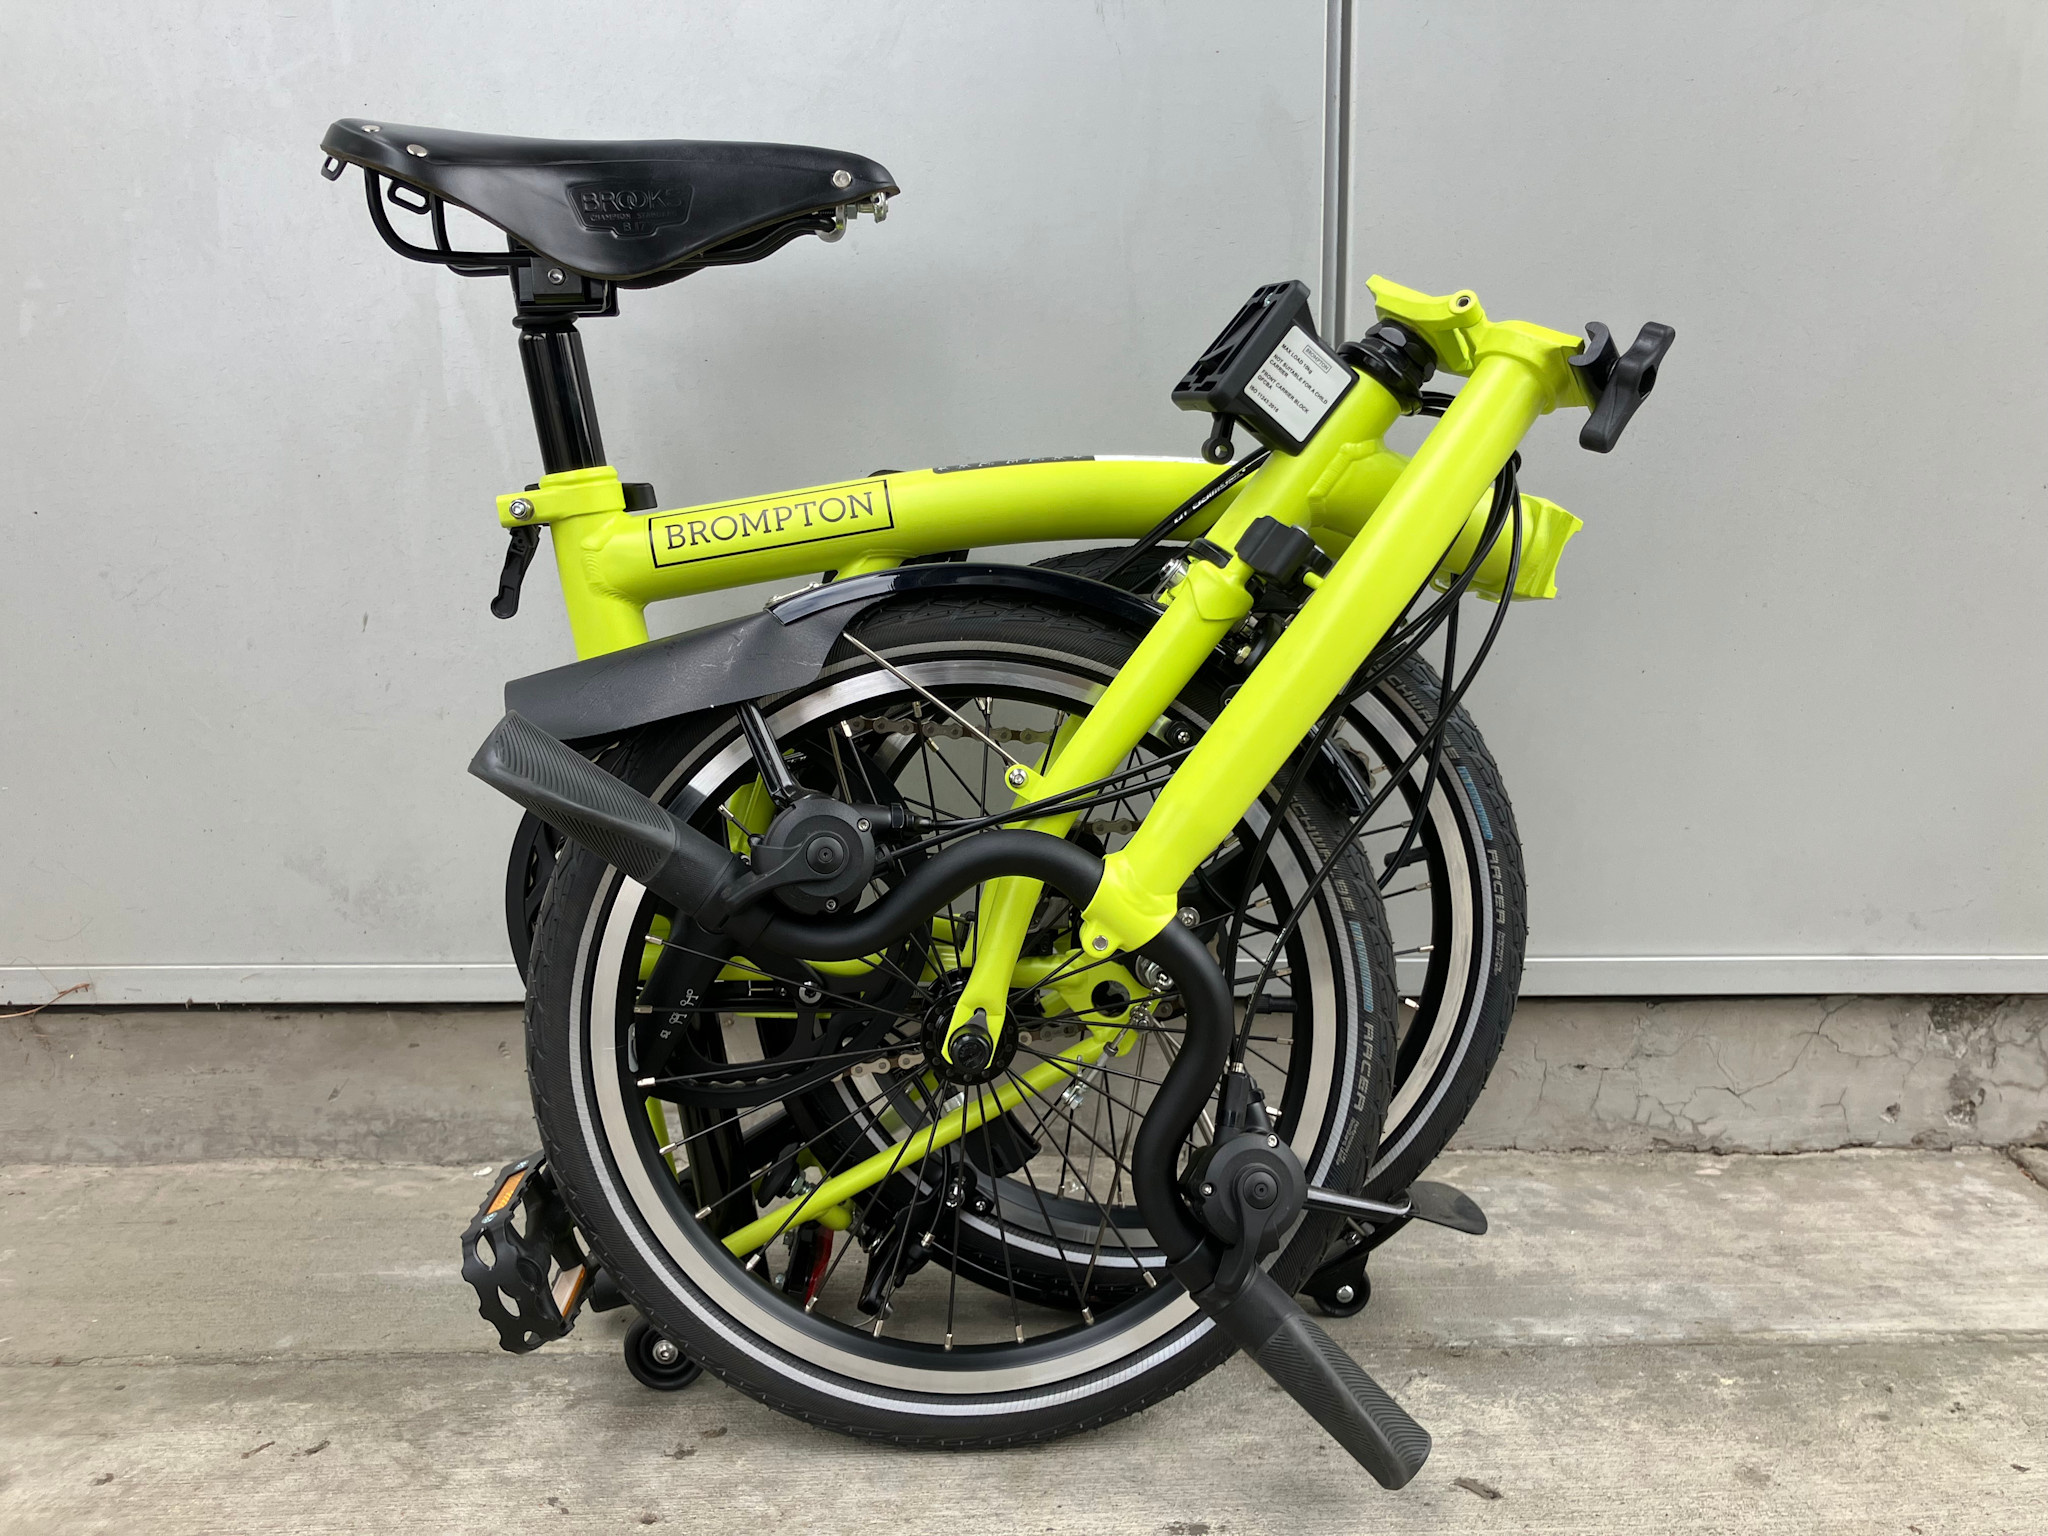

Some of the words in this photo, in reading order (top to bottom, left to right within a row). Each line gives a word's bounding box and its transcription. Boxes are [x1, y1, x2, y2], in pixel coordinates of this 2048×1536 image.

[581, 189, 682, 212] BROOKS
[1268, 359, 1289, 377] CARRIER
[1280, 343, 1292, 354] MAX
[1290, 352, 1304, 365] LOAD
[1304, 348, 1329, 370] BROMPTON
[1248, 384, 1258, 393] ISO
[1260, 369, 1276, 384] FRONT
[1274, 382, 1294, 400] CARRIER
[1293, 398, 1309, 413] BLOCK
[1272, 354, 1283, 364] NOT
[1281, 362, 1302, 382] SUITABLE
[1301, 380, 1312, 390] FOR
[1313, 391, 1328, 405] CHILD
[664, 491, 874, 550] BROMPTON
[1487, 848, 1506, 925] RACER
[1353, 1021, 1375, 1112] RACER
